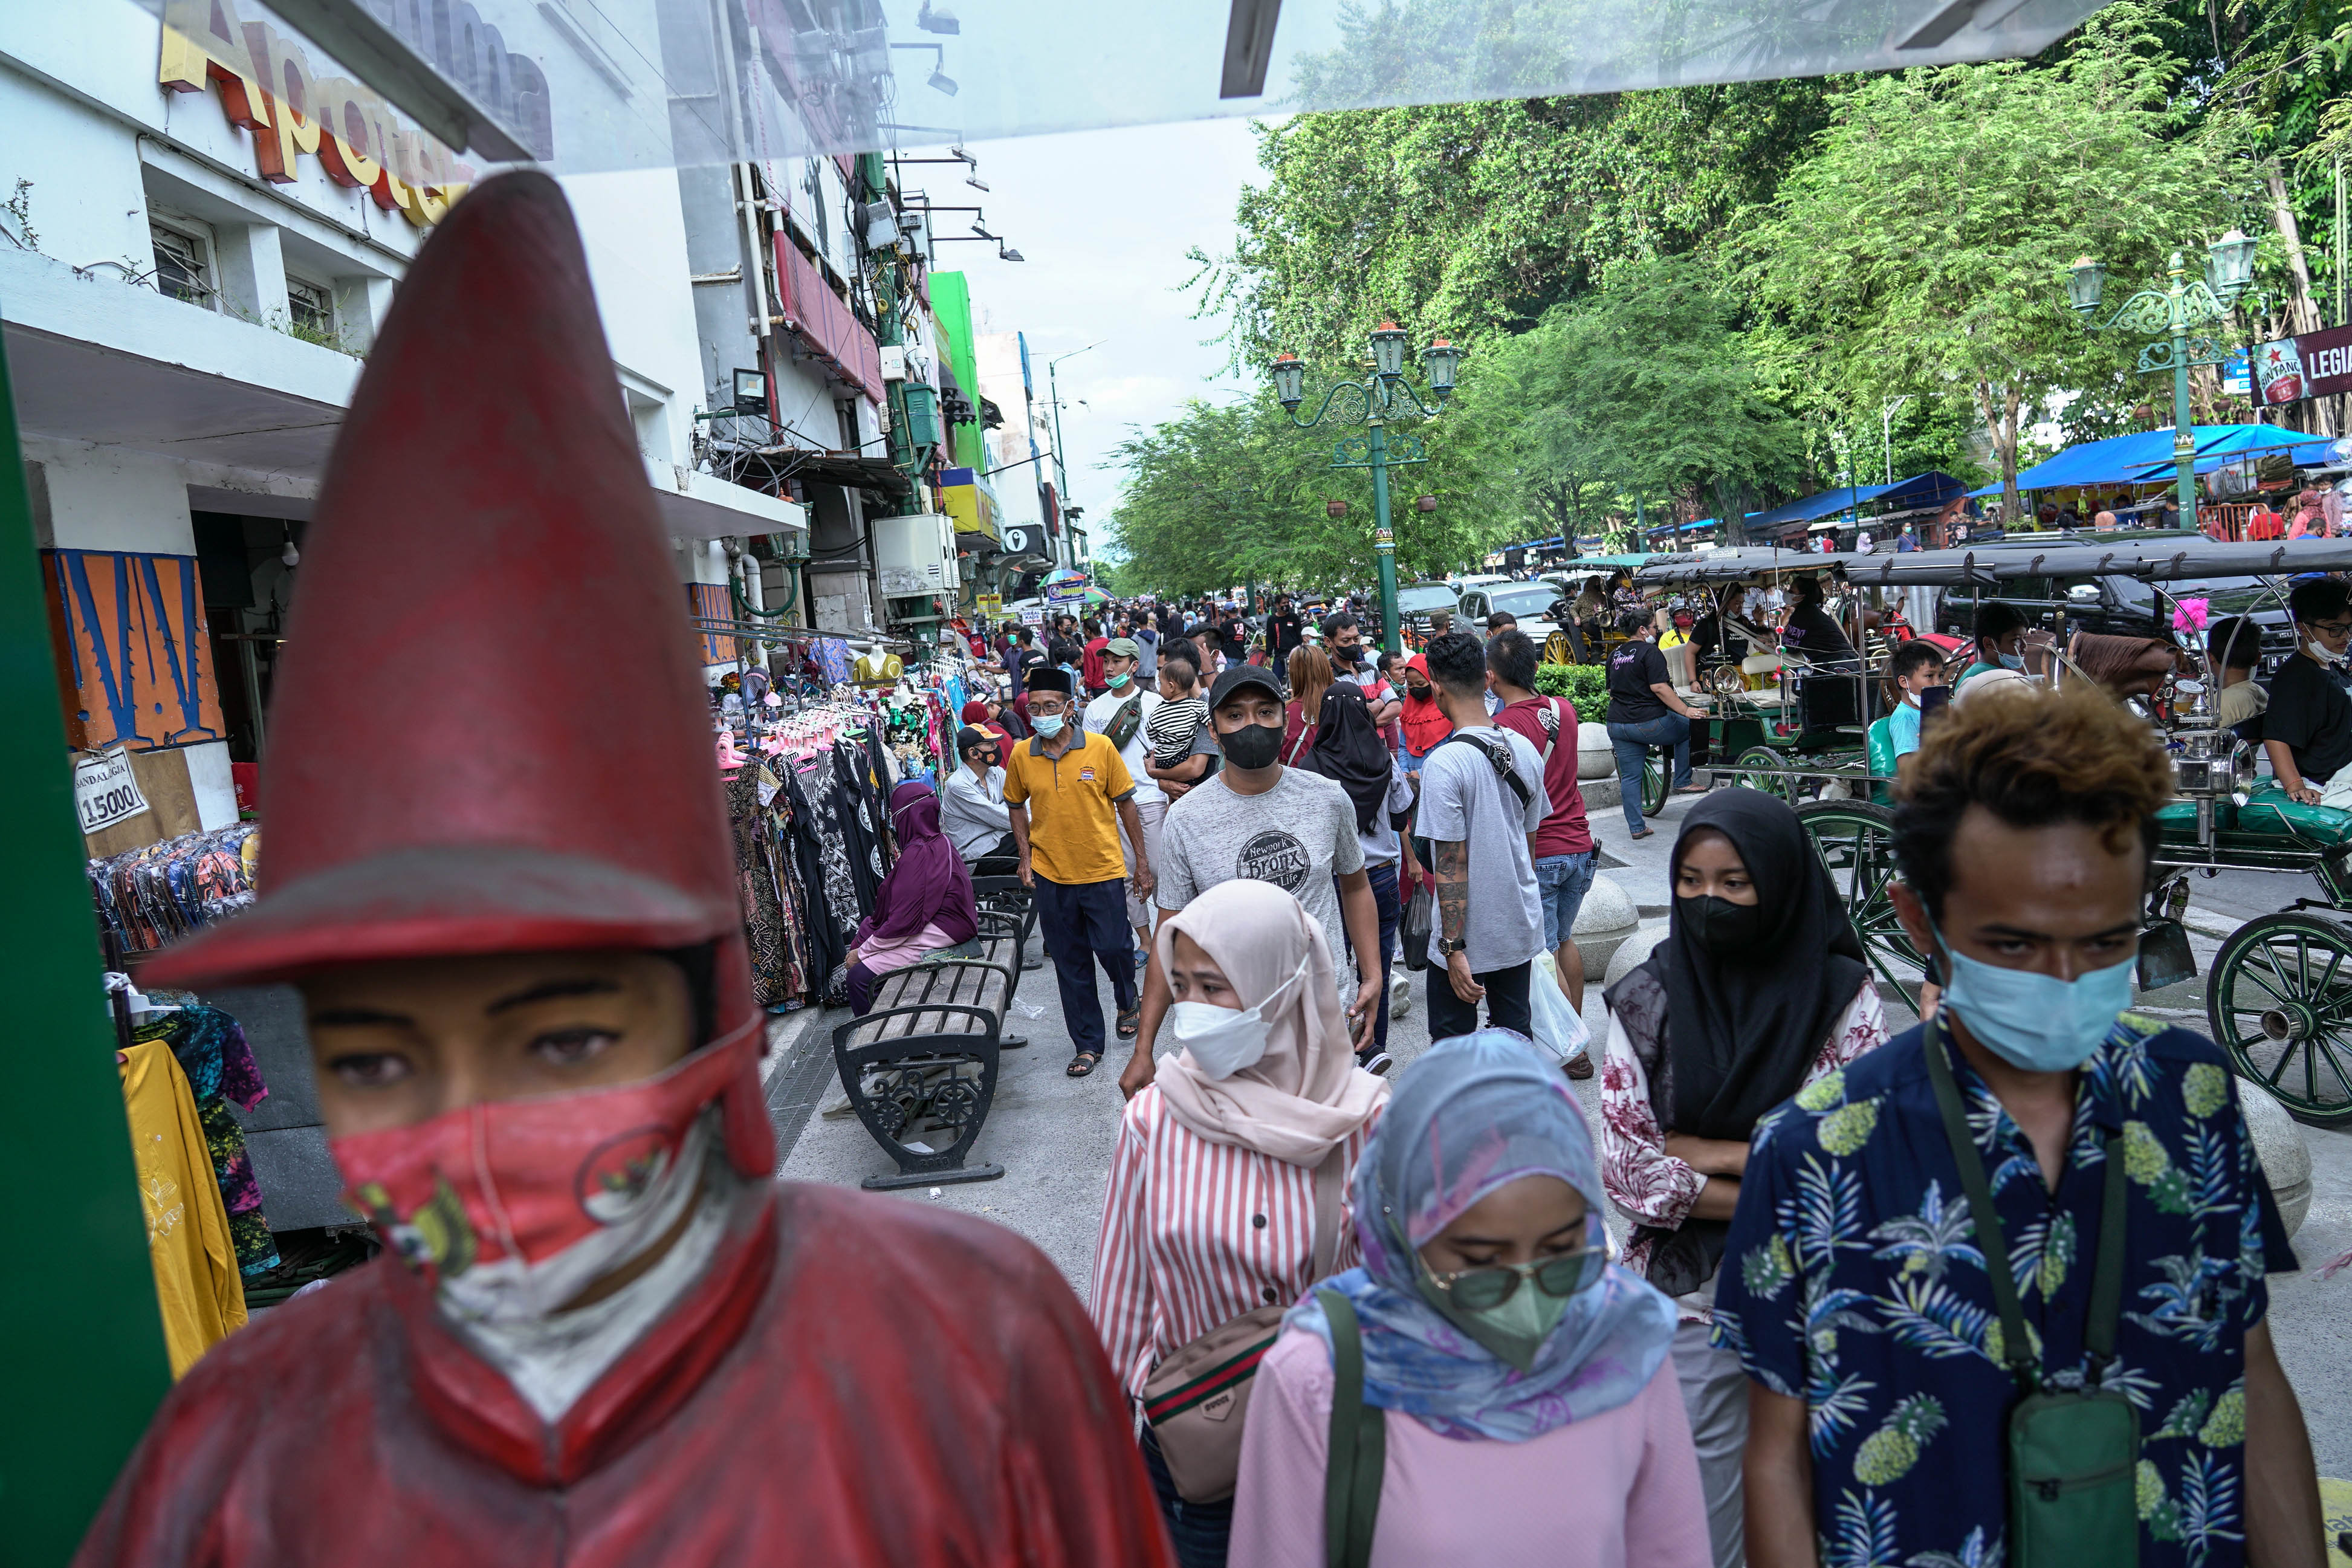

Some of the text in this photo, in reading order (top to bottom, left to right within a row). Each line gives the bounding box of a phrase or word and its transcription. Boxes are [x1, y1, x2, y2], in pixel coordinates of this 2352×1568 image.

[76, 771, 109, 789] SANDAL
[83, 785, 135, 823] 15000
[1246, 850, 1306, 880] Bronx
[1280, 873, 1298, 887] Life
